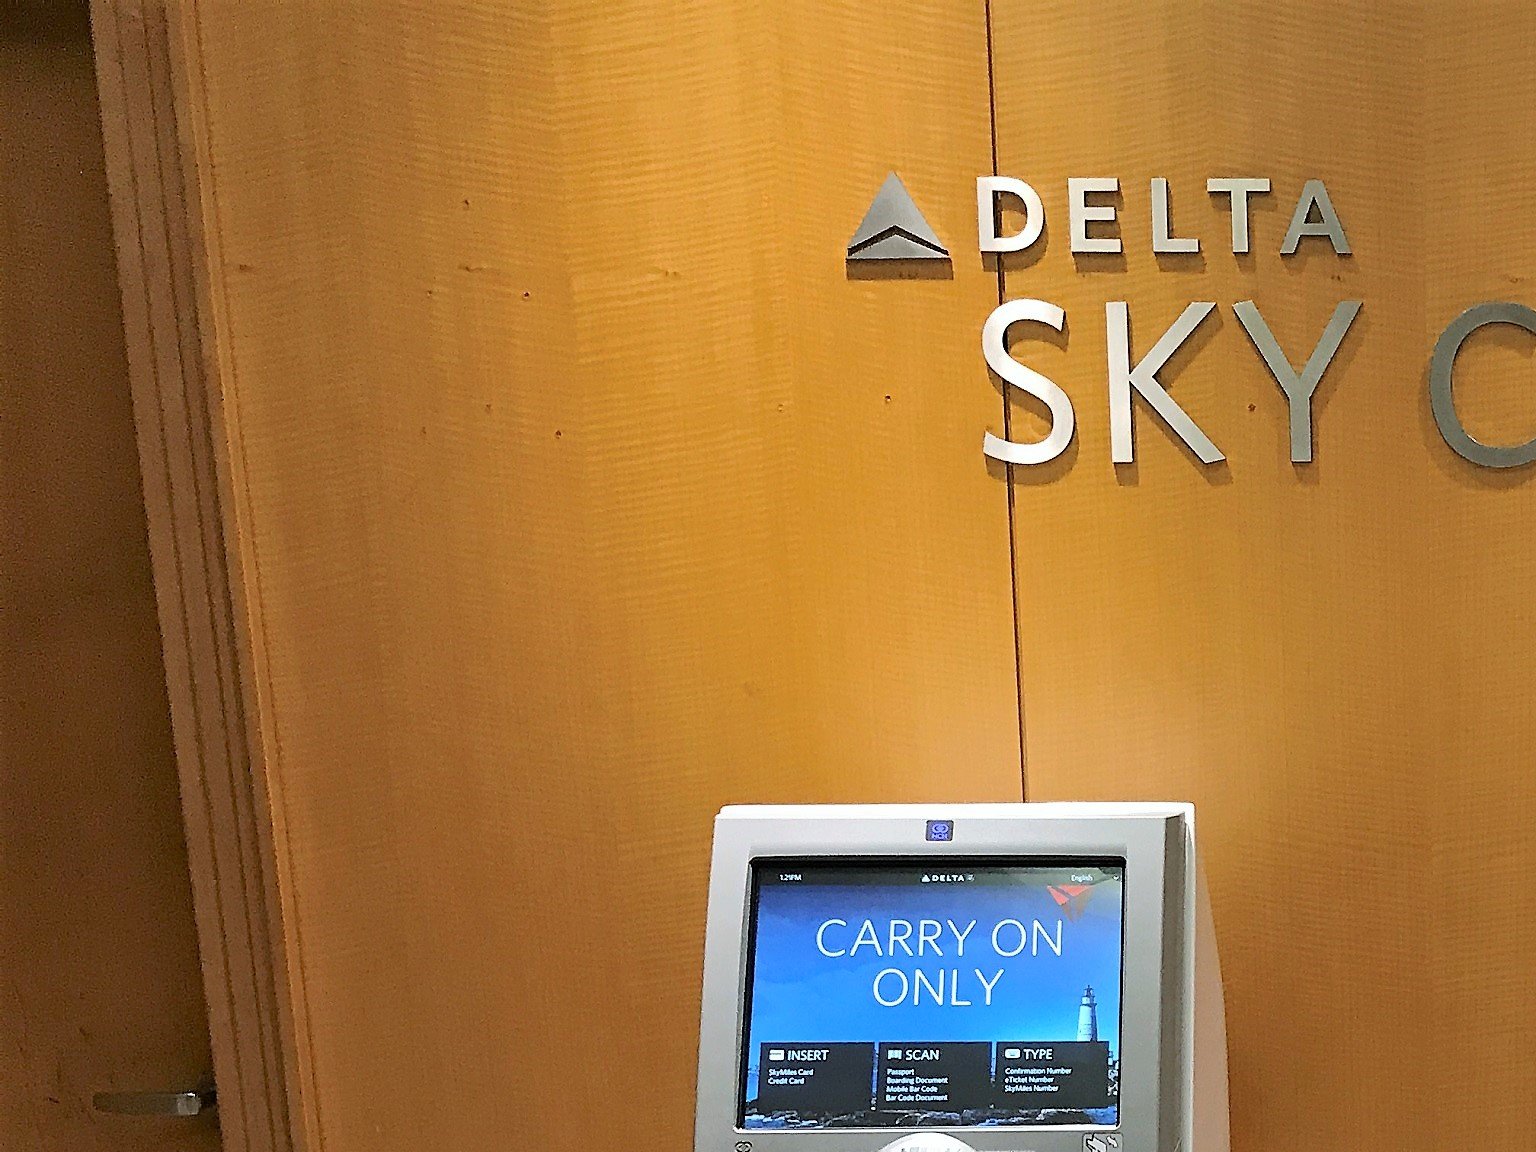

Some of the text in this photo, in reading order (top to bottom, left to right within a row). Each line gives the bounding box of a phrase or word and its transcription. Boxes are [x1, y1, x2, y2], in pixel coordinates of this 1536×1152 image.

[976, 176, 1353, 254] DELTA
[981, 298, 1364, 465] SKY
[932, 874, 965, 882] DELTA
[816, 919, 1064, 957] CARRY ON
[872, 968, 1005, 1007] ONLY
[787, 1050, 830, 1061] INSERT
[905, 1050, 940, 1061] SCAN
[1023, 1049, 1053, 1060] TYPE
[798, 1068, 814, 1077] Card
[887, 1068, 915, 1076] Passport
[767, 1077, 805, 1085] Credit Card
[1034, 1085, 1060, 1093] Number
